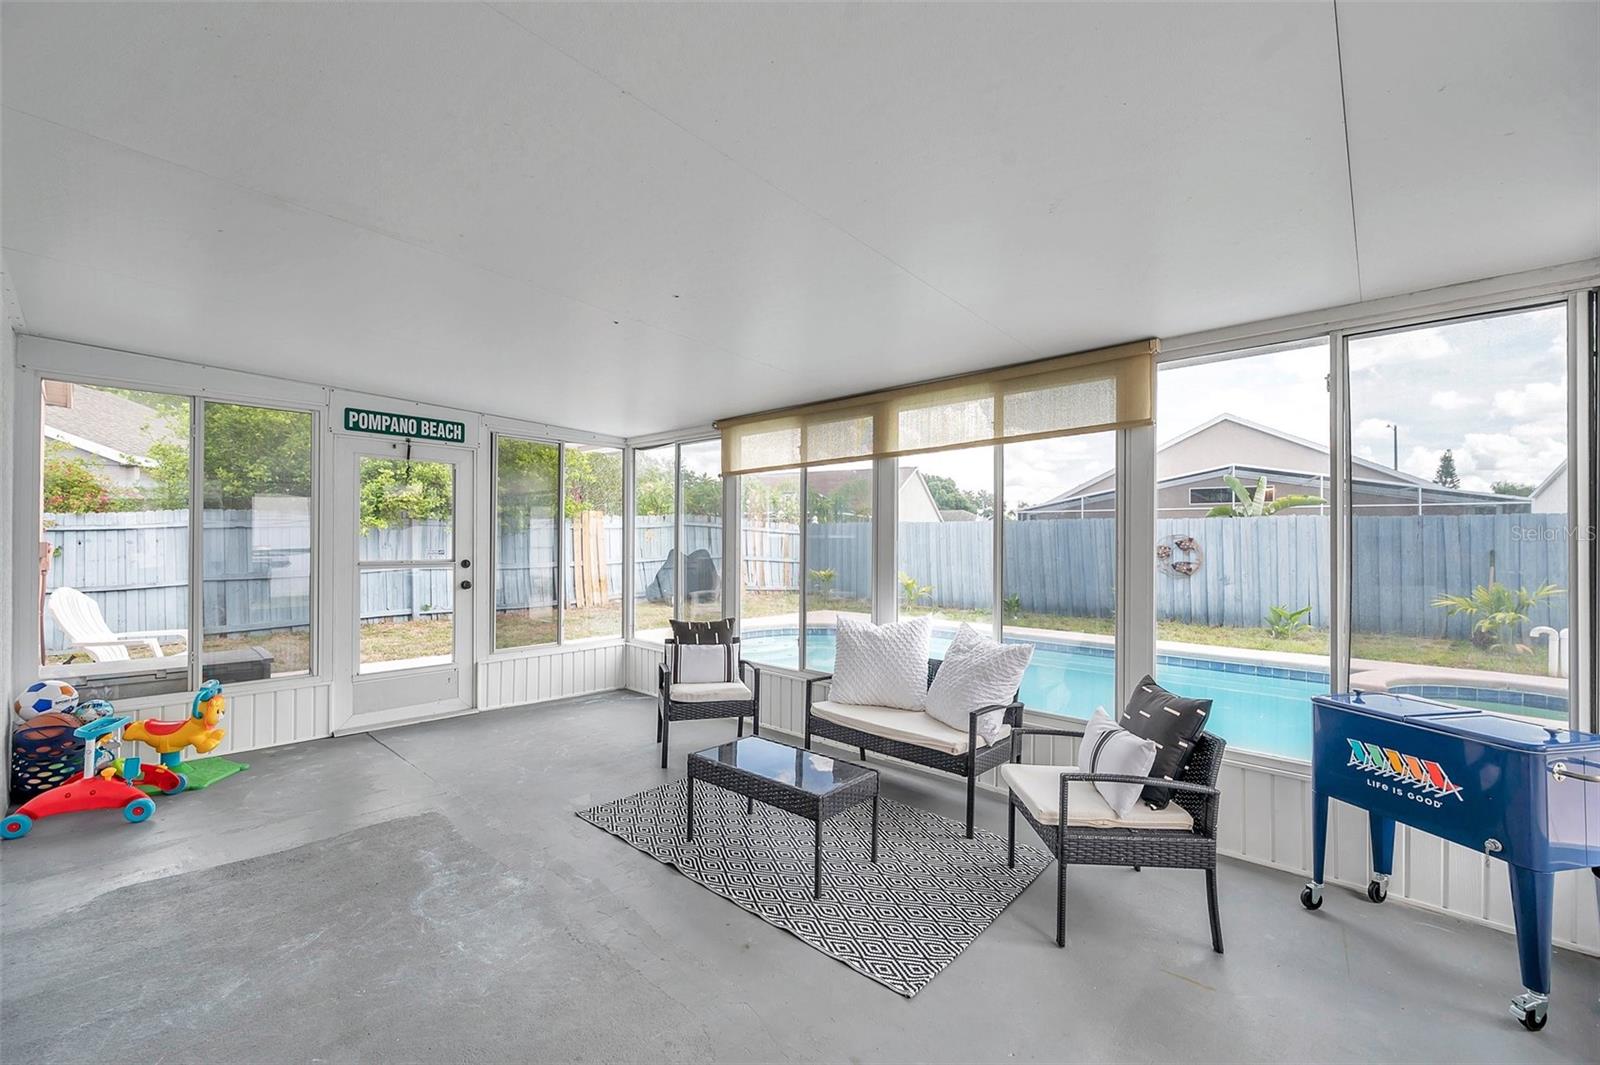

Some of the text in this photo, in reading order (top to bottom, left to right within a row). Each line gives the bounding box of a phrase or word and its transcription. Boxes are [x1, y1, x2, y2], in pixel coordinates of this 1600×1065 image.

[348, 411, 462, 440] POMPANO BEACH
[1392, 786, 1403, 796] IS
[1407, 791, 1442, 808] GOOD
